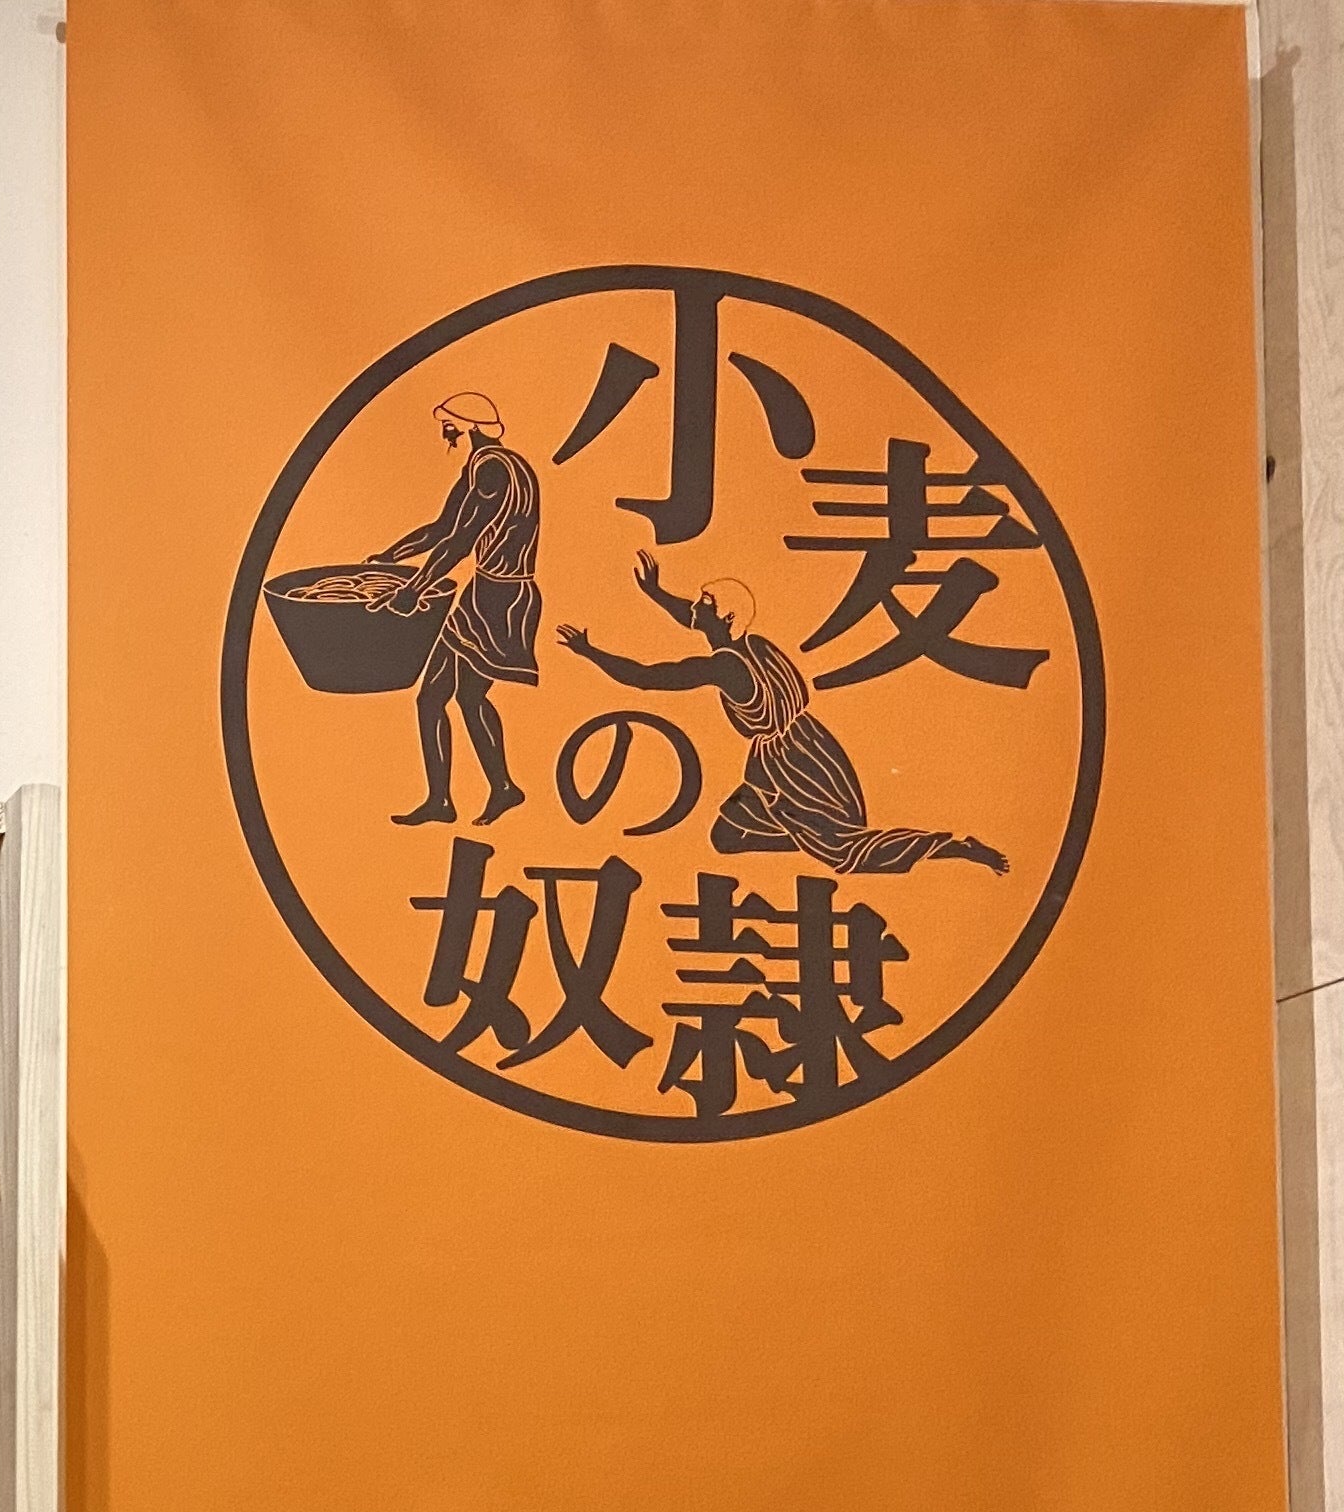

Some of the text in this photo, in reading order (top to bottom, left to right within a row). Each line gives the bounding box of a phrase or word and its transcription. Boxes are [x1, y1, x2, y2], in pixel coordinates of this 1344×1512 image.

[552, 288, 1050, 690] 小麦
[555, 711, 702, 836] の
[409, 837, 909, 1117] 奴隷
